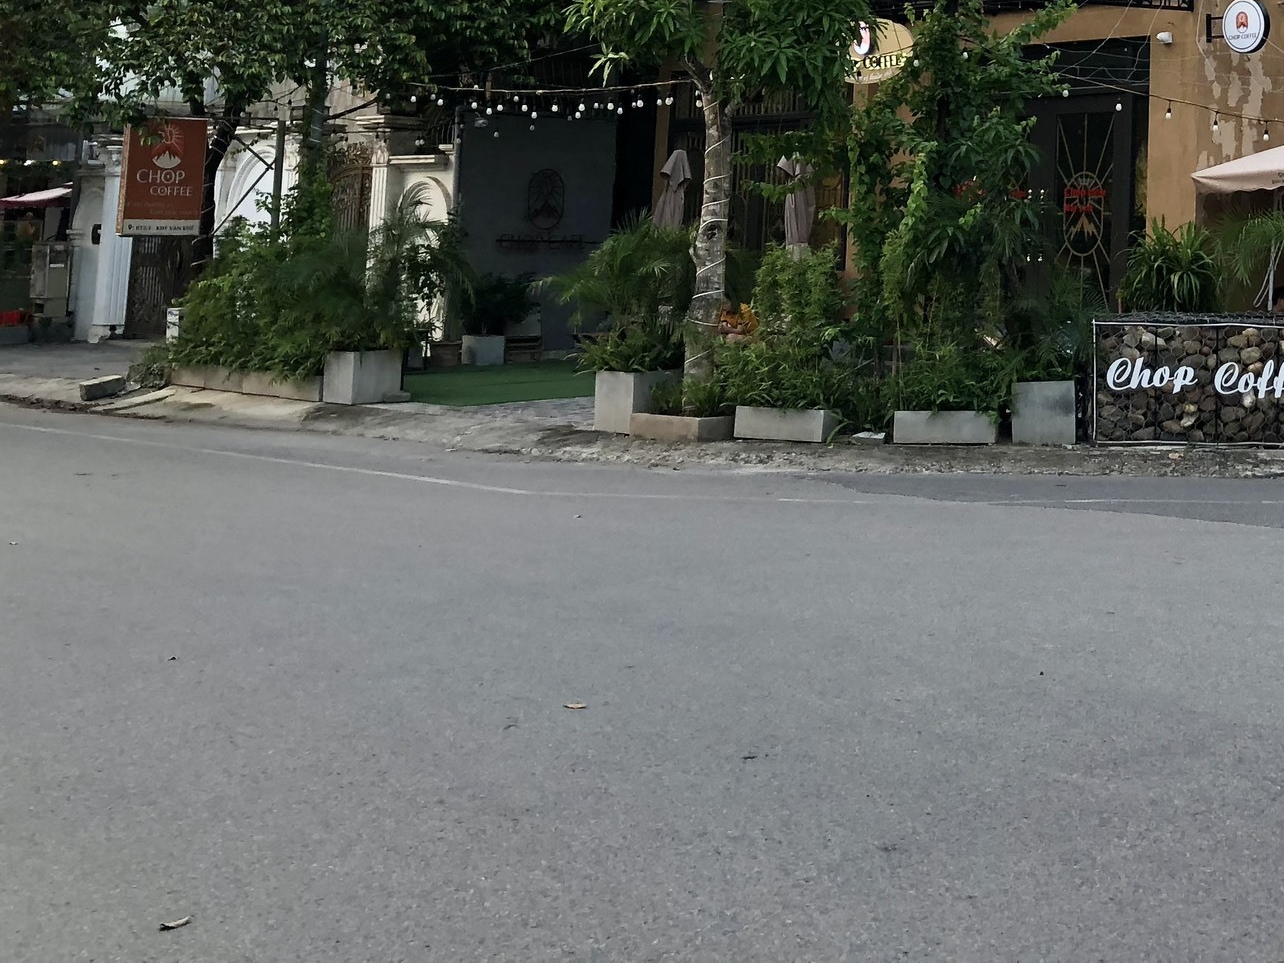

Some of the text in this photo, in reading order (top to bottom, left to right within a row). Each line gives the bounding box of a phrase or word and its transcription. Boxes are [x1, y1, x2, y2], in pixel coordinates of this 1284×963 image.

[136, 168, 186, 184] CHOP
[149, 186, 193, 197] COFFEE
[1106, 357, 1198, 394] Chop
